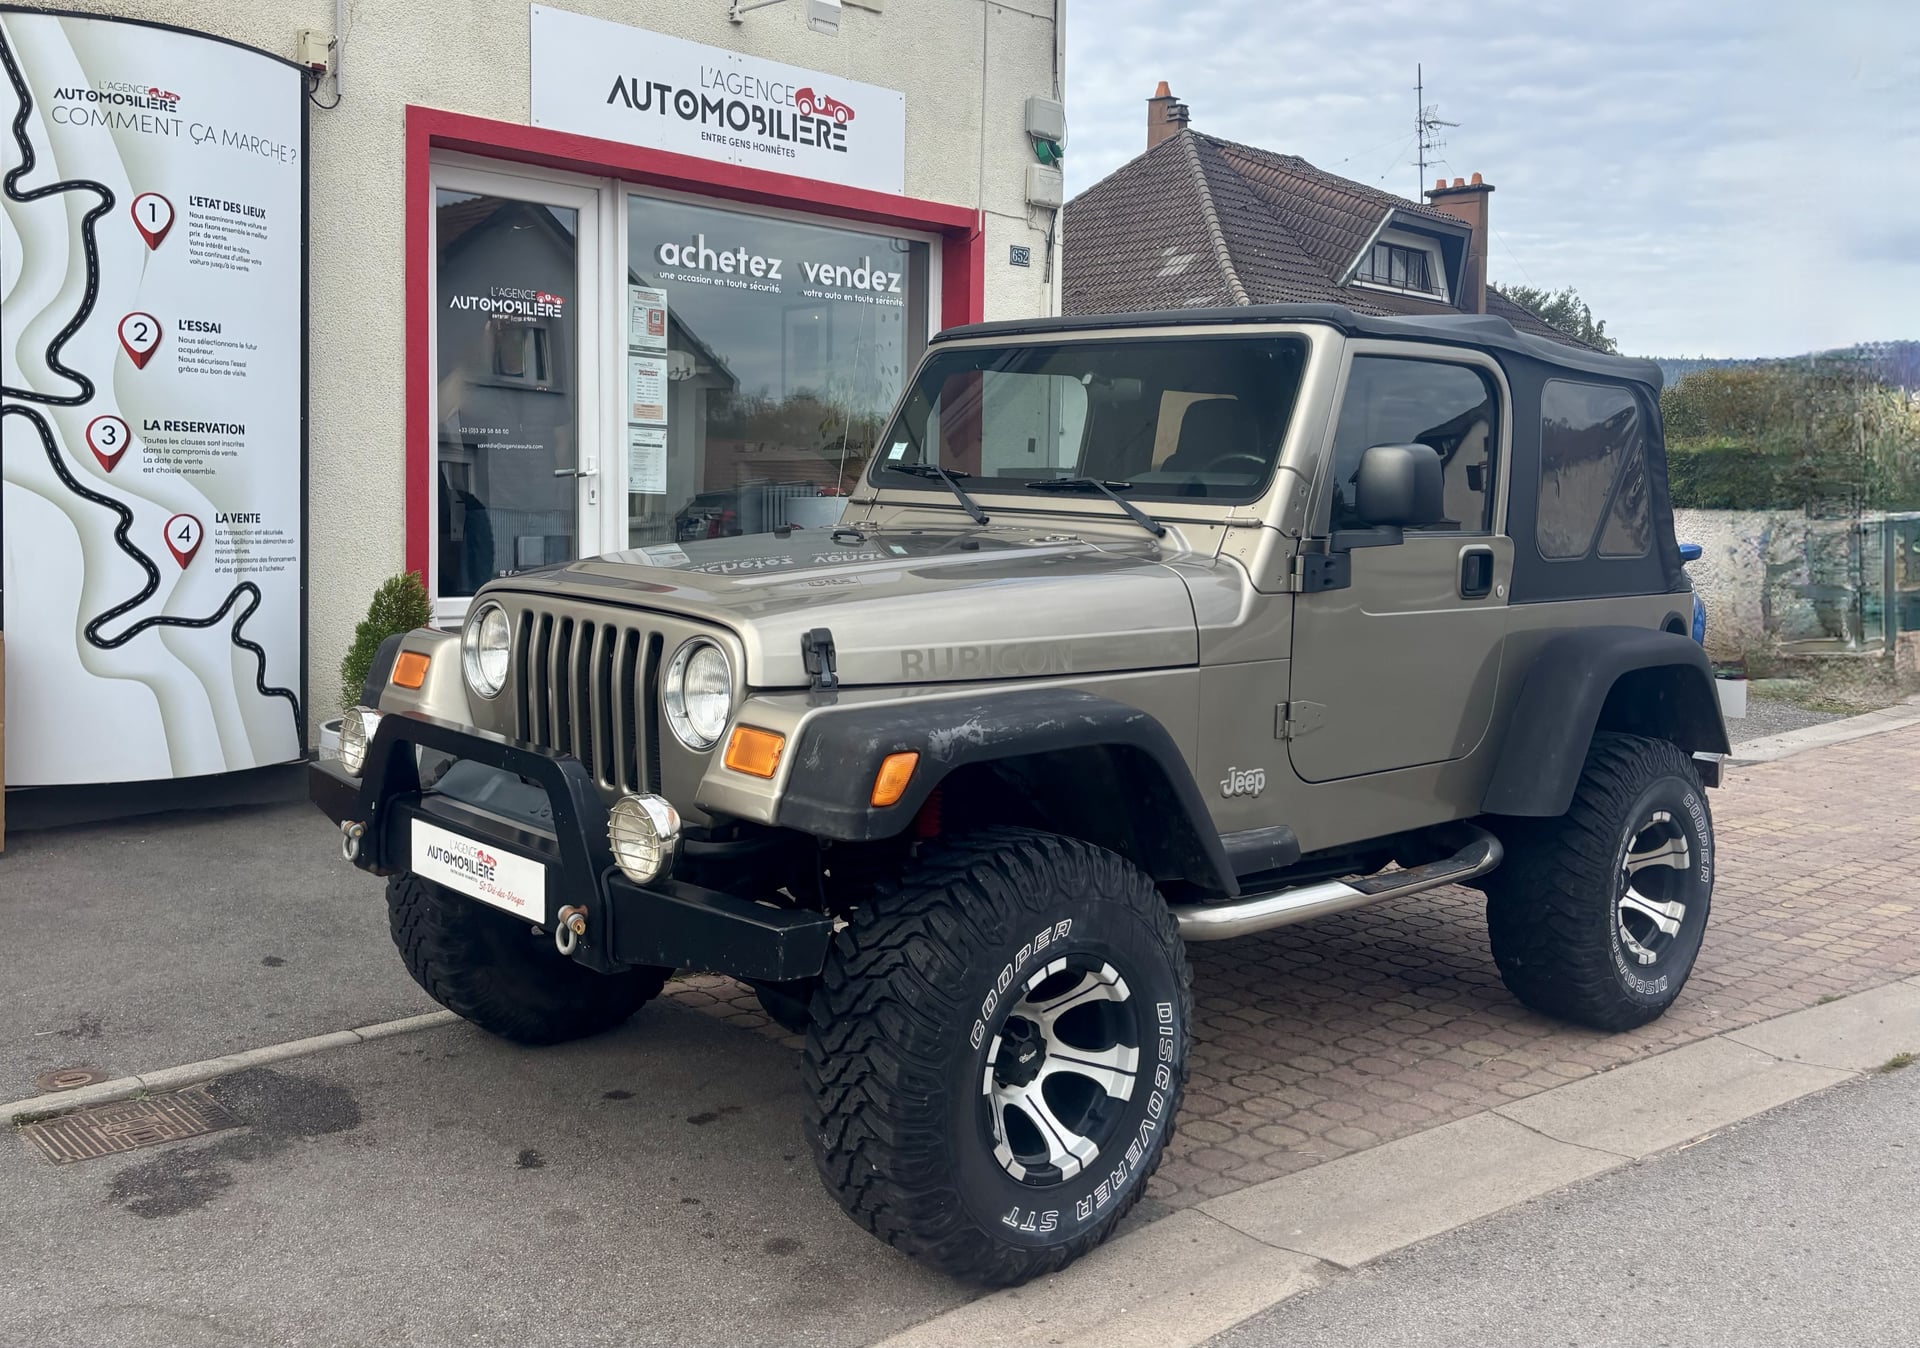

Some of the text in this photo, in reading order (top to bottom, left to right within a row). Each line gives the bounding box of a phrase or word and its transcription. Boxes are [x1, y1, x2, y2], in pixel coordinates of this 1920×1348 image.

[99, 80, 148, 94] L'AGENCE
[701, 66, 795, 107] L'AGENCE
[52, 106, 183, 136] COMMENT
[190, 123, 216, 145] ÇA
[702, 132, 796, 158] ENTRE GENS HONNÊTES
[149, 203, 156, 222] 1
[189, 195, 266, 219] L'ETAT DES LIEUX
[189, 211, 204, 219] Nous
[189, 248, 203, 256] Vous
[660, 234, 782, 280] achetez
[1012, 249, 1028, 263] 652
[660, 271, 782, 293] une occasion en toute sécurité.
[803, 256, 901, 292] vendez
[491, 286, 536, 300] L'AGENCE
[803, 290, 822, 298] votre
[825, 292, 841, 300] auto
[855, 294, 874, 303] toute
[134, 322, 148, 342] 2
[179, 319, 221, 334] L'ESSAI
[178, 336, 196, 344] Nous
[102, 425, 116, 446] 3
[144, 419, 245, 435] LA RESERVATION
[143, 446, 162, 454] dans
[172, 448, 210, 456] compromis
[181, 438, 206, 446] clauses
[154, 456, 171, 464] date
[216, 513, 261, 523] LA VENTE
[177, 524, 191, 542] 4
[901, 644, 1072, 678] RUBICON
[1220, 767, 1265, 797] Jeep
[1683, 794, 1709, 882] COOPER
[970, 918, 1072, 1050] COOPER
[1002, 1002, 1173, 1232] DISCOVERER STT
